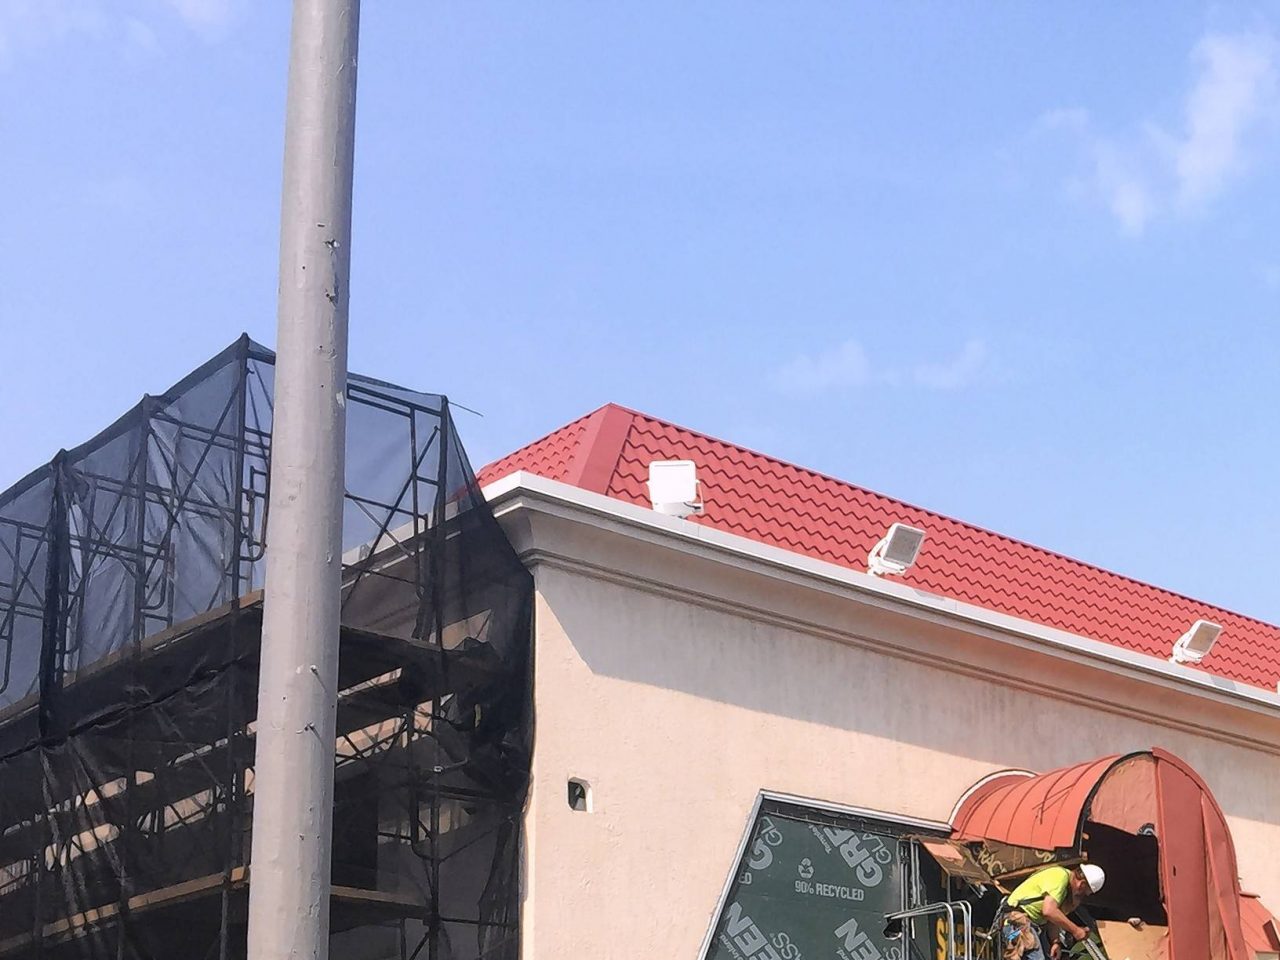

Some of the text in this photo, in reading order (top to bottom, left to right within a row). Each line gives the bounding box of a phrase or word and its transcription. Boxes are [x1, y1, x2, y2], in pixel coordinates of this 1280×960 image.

[822, 827, 884, 887] GRE
[795, 880, 865, 902] 90% RECYCLED
